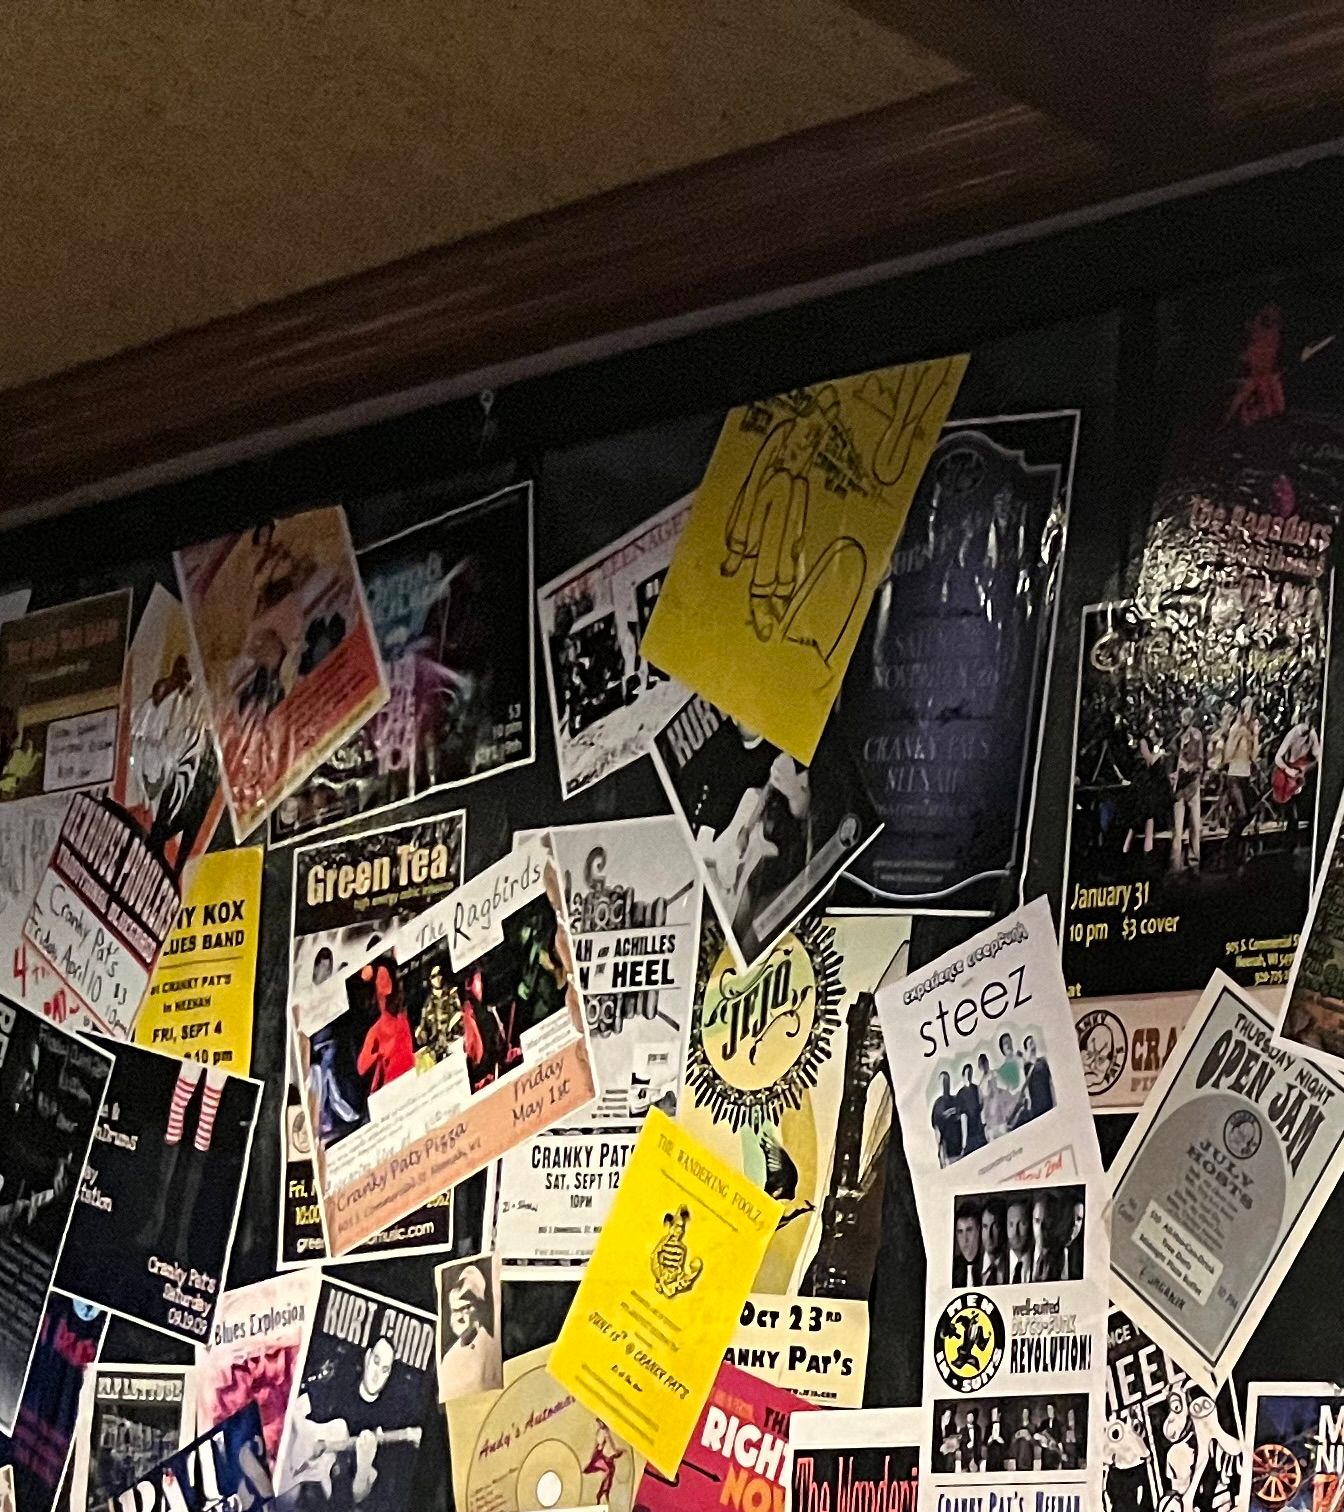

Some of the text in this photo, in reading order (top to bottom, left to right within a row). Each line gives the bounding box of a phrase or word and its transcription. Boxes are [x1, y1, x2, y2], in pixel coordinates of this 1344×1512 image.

[307, 856, 391, 907] Green
[397, 843, 448, 888] Tea
[203, 899, 246, 927] KOX
[416, 921, 447, 949] The
[452, 862, 542, 950] Ragbirds
[1070, 881, 1150, 912] January 31
[202, 929, 245, 950] BAND
[613, 934, 676, 958] ACHILLES
[1069, 915, 1180, 947] 10 pm $3 cover
[611, 958, 675, 988] HEEL
[214, 1020, 223, 1036] 4
[919, 964, 1033, 1058] steez
[1131, 1026, 1178, 1072] CRA
[512, 1056, 566, 1102] Friday
[1296, 1067, 1337, 1106] NIGHT
[511, 1101, 544, 1127] May
[1195, 1027, 1277, 1105] OPEN
[1267, 1082, 1328, 1181] JAM
[337, 1169, 389, 1213] Cranky
[424, 1120, 469, 1163] Pizza
[531, 1143, 637, 1169] CRANKY PAT'
[676, 1147, 729, 1198] WANDERING
[545, 1170, 621, 1191] SAT. SEPT 12
[569, 1194, 593, 1210] 10PM
[214, 1301, 306, 1346] Blues Explosion
[322, 1286, 379, 1349] KURT
[1009, 1334, 1093, 1374] REVOLUTION!
